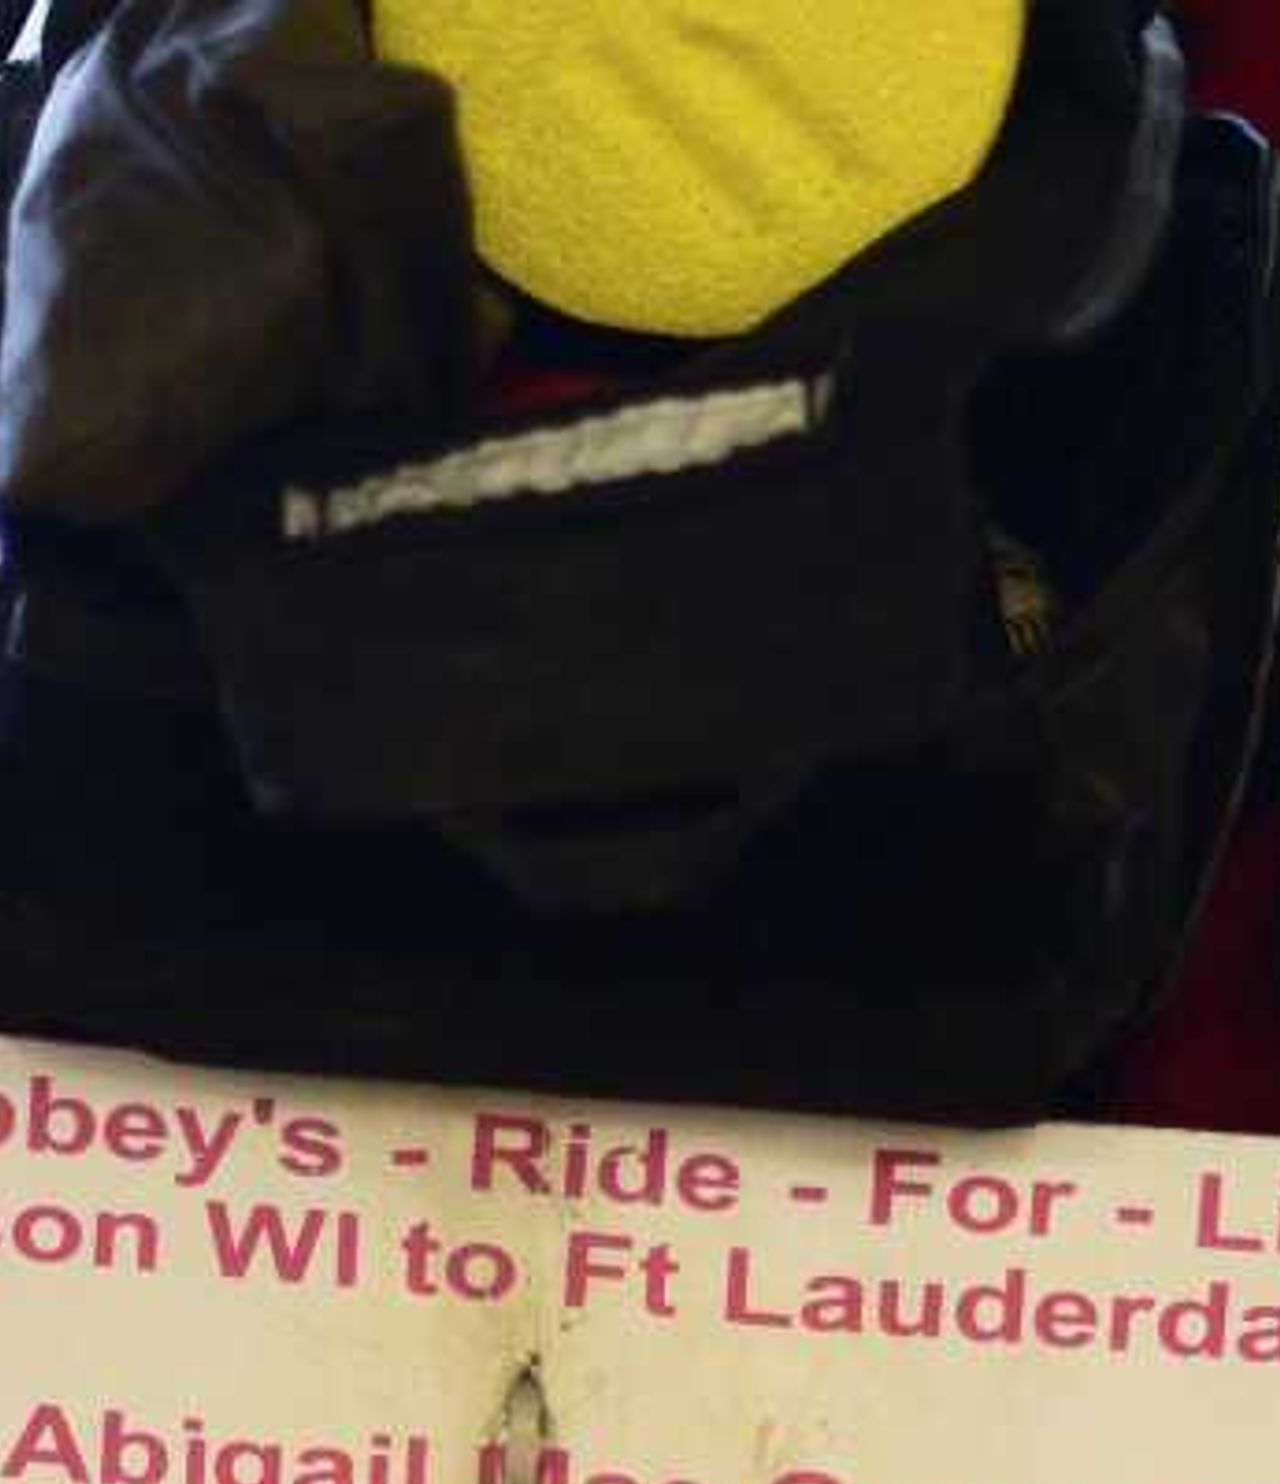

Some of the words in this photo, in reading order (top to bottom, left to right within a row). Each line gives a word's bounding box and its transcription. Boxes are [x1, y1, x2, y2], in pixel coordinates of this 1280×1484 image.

[469, 1112, 739, 1212] Ride
[868, 1148, 1075, 1238] For
[207, 1204, 358, 1289] WI
[403, 1223, 517, 1301] to
[563, 1232, 681, 1316] Ft
